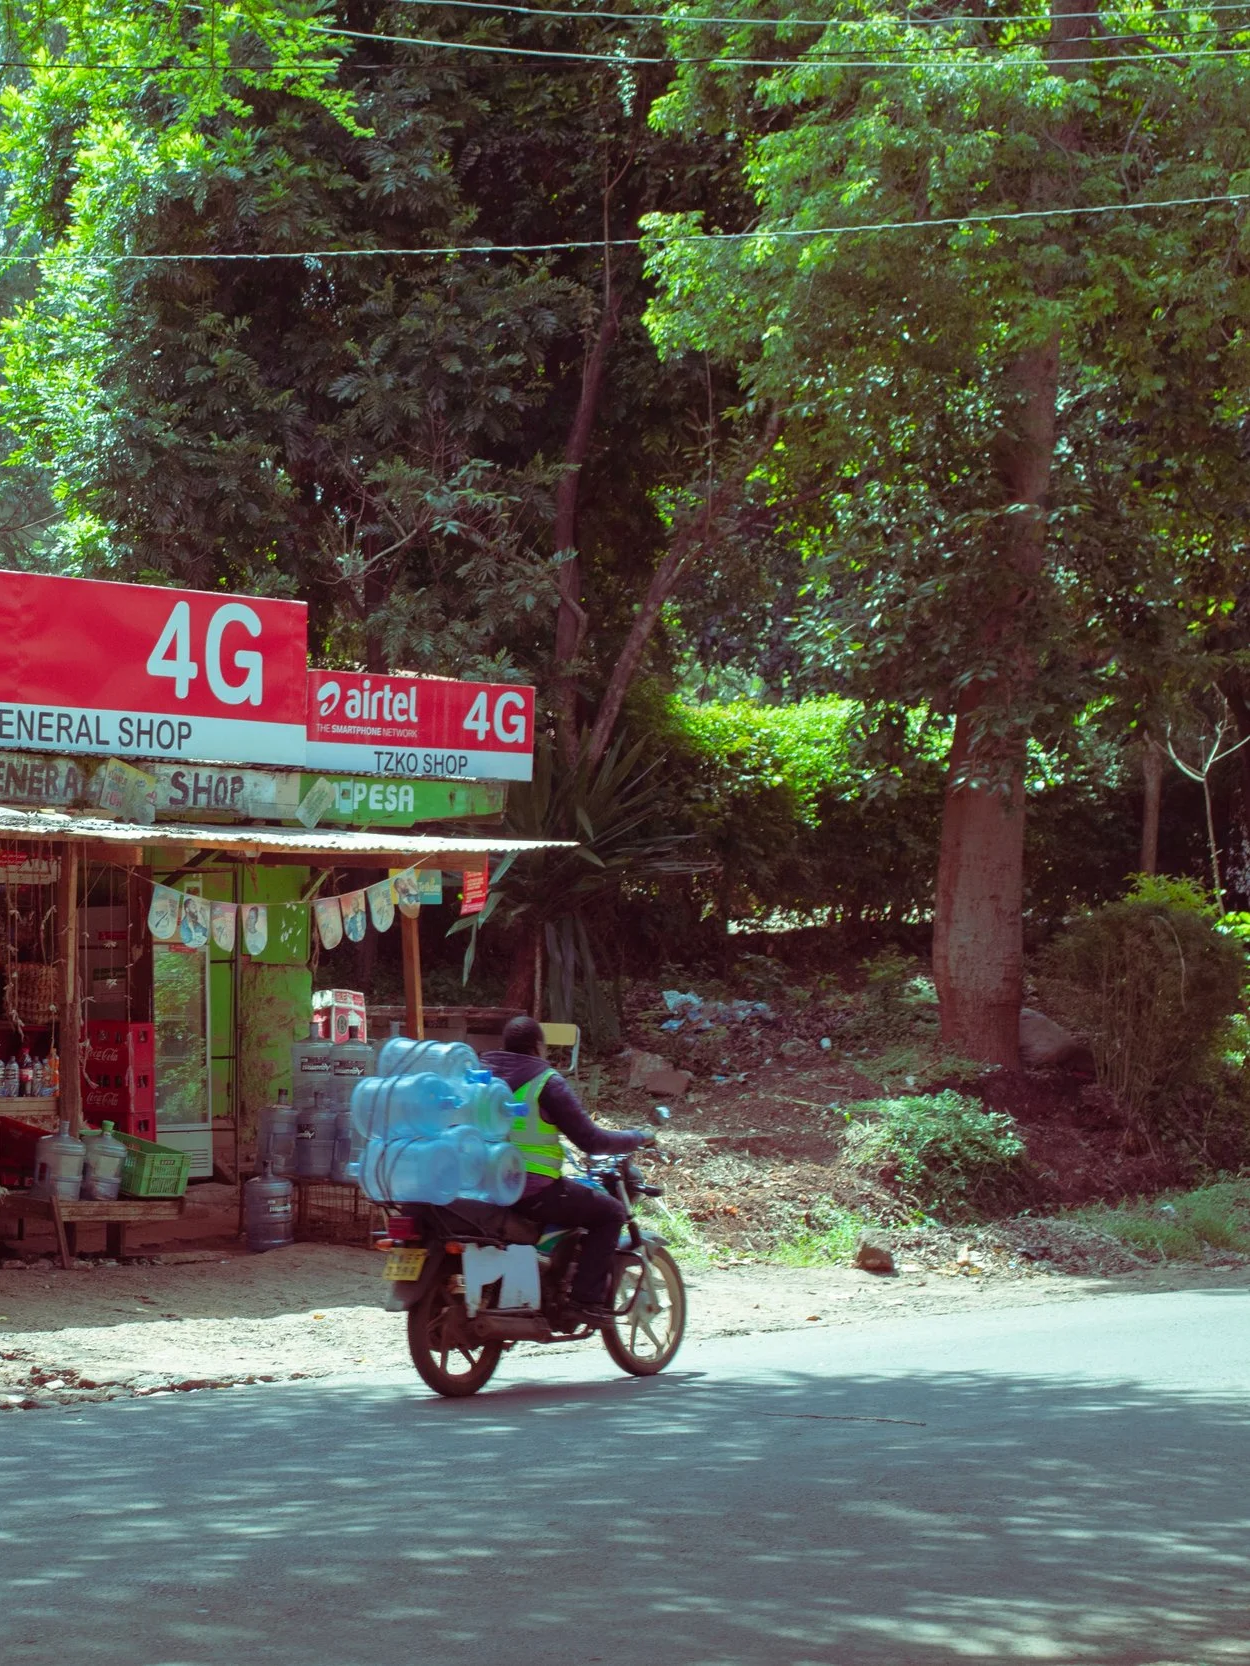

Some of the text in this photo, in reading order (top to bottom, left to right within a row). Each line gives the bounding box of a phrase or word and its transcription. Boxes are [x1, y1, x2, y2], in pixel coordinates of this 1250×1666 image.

[146, 600, 263, 707] 4G
[344, 679, 419, 723] airtel
[463, 690, 527, 744] 4G
[118, 718, 193, 751] SHOP
[316, 723, 418, 739] THE SMARTPHONE NETWORK
[374, 751, 469, 775] TZKO SHOP
[169, 770, 246, 809] SHOP
